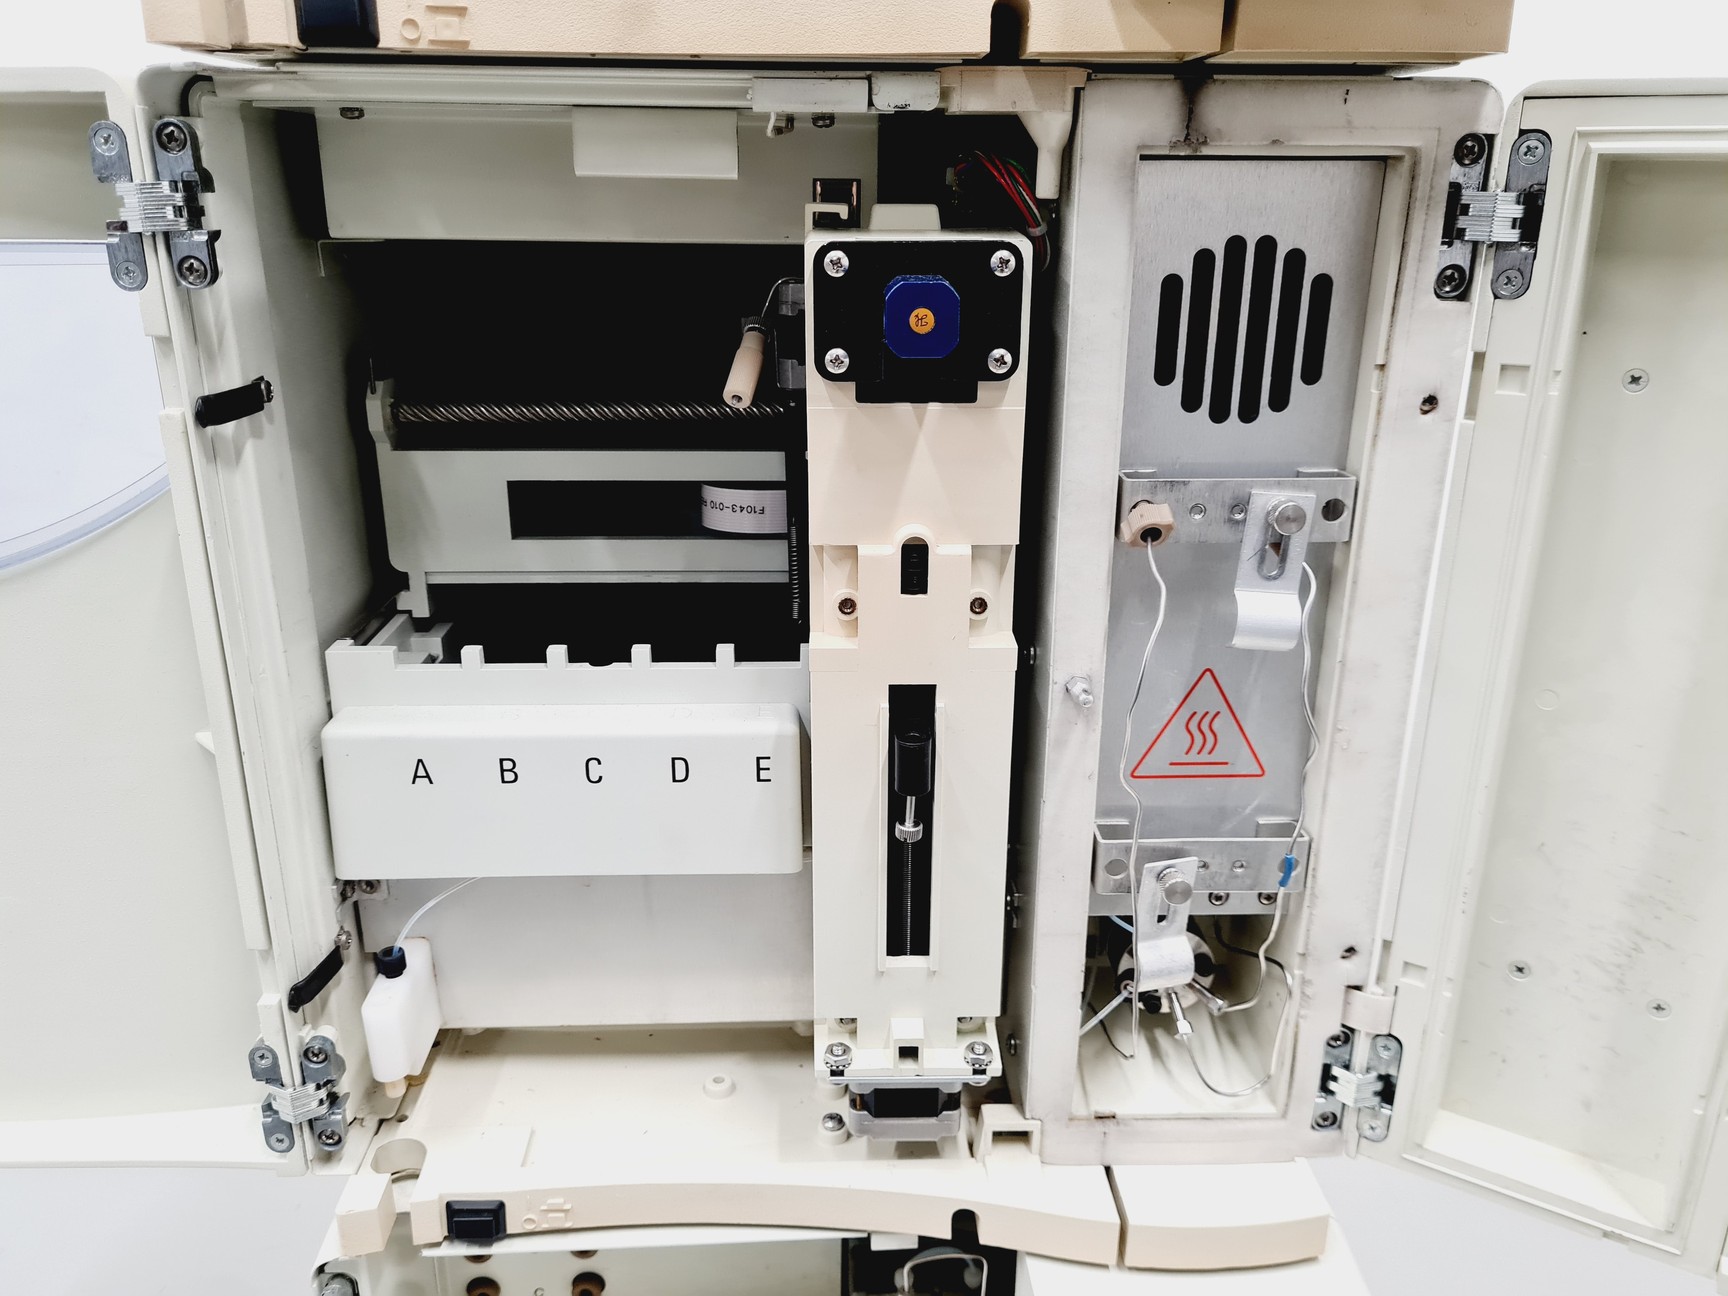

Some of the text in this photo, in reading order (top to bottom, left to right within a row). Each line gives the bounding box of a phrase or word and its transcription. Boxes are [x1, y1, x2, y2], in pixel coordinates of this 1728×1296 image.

[709, 500, 765, 515] F1043-010
[411, 755, 772, 785] A B C D E
